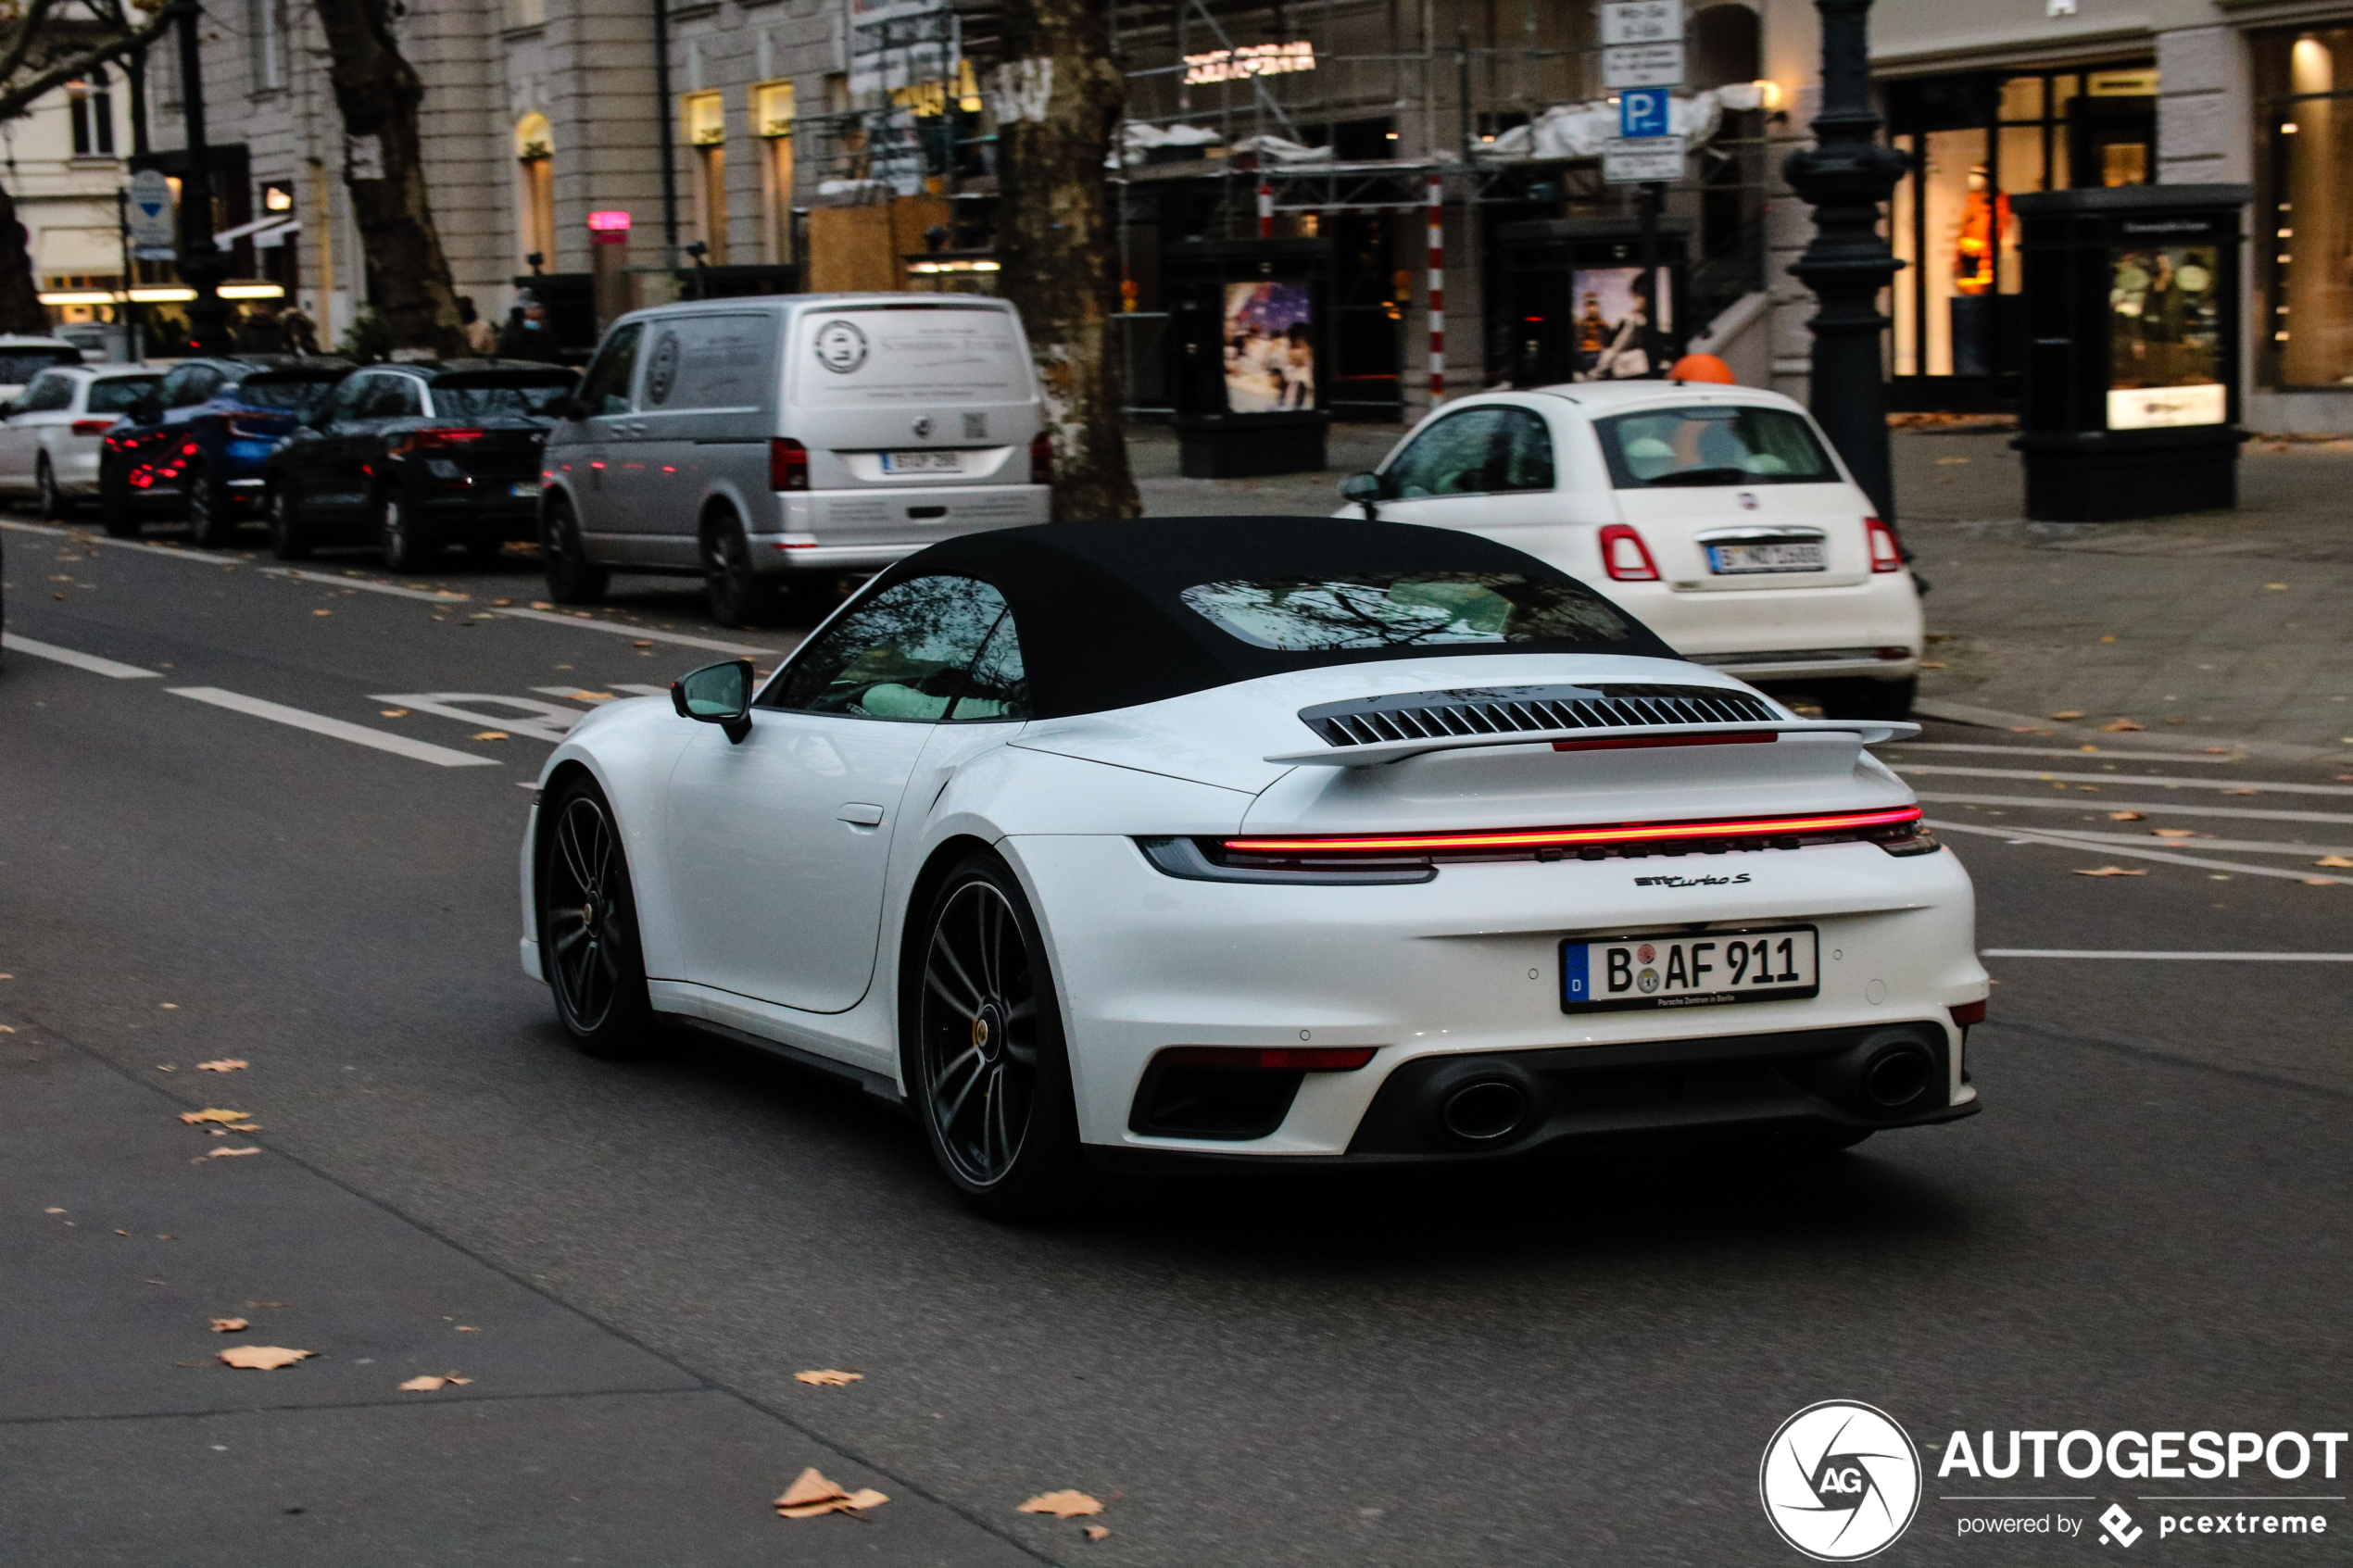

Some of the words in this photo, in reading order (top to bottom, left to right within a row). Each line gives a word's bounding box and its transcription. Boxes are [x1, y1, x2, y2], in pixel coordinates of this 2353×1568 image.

[1627, 94, 1655, 132] P
[1731, 873, 1751, 884] S
[1607, 947, 1633, 993] B
[1665, 942, 1716, 990] AF
[1727, 937, 1799, 985] 911
[1572, 979, 1581, 992] D
